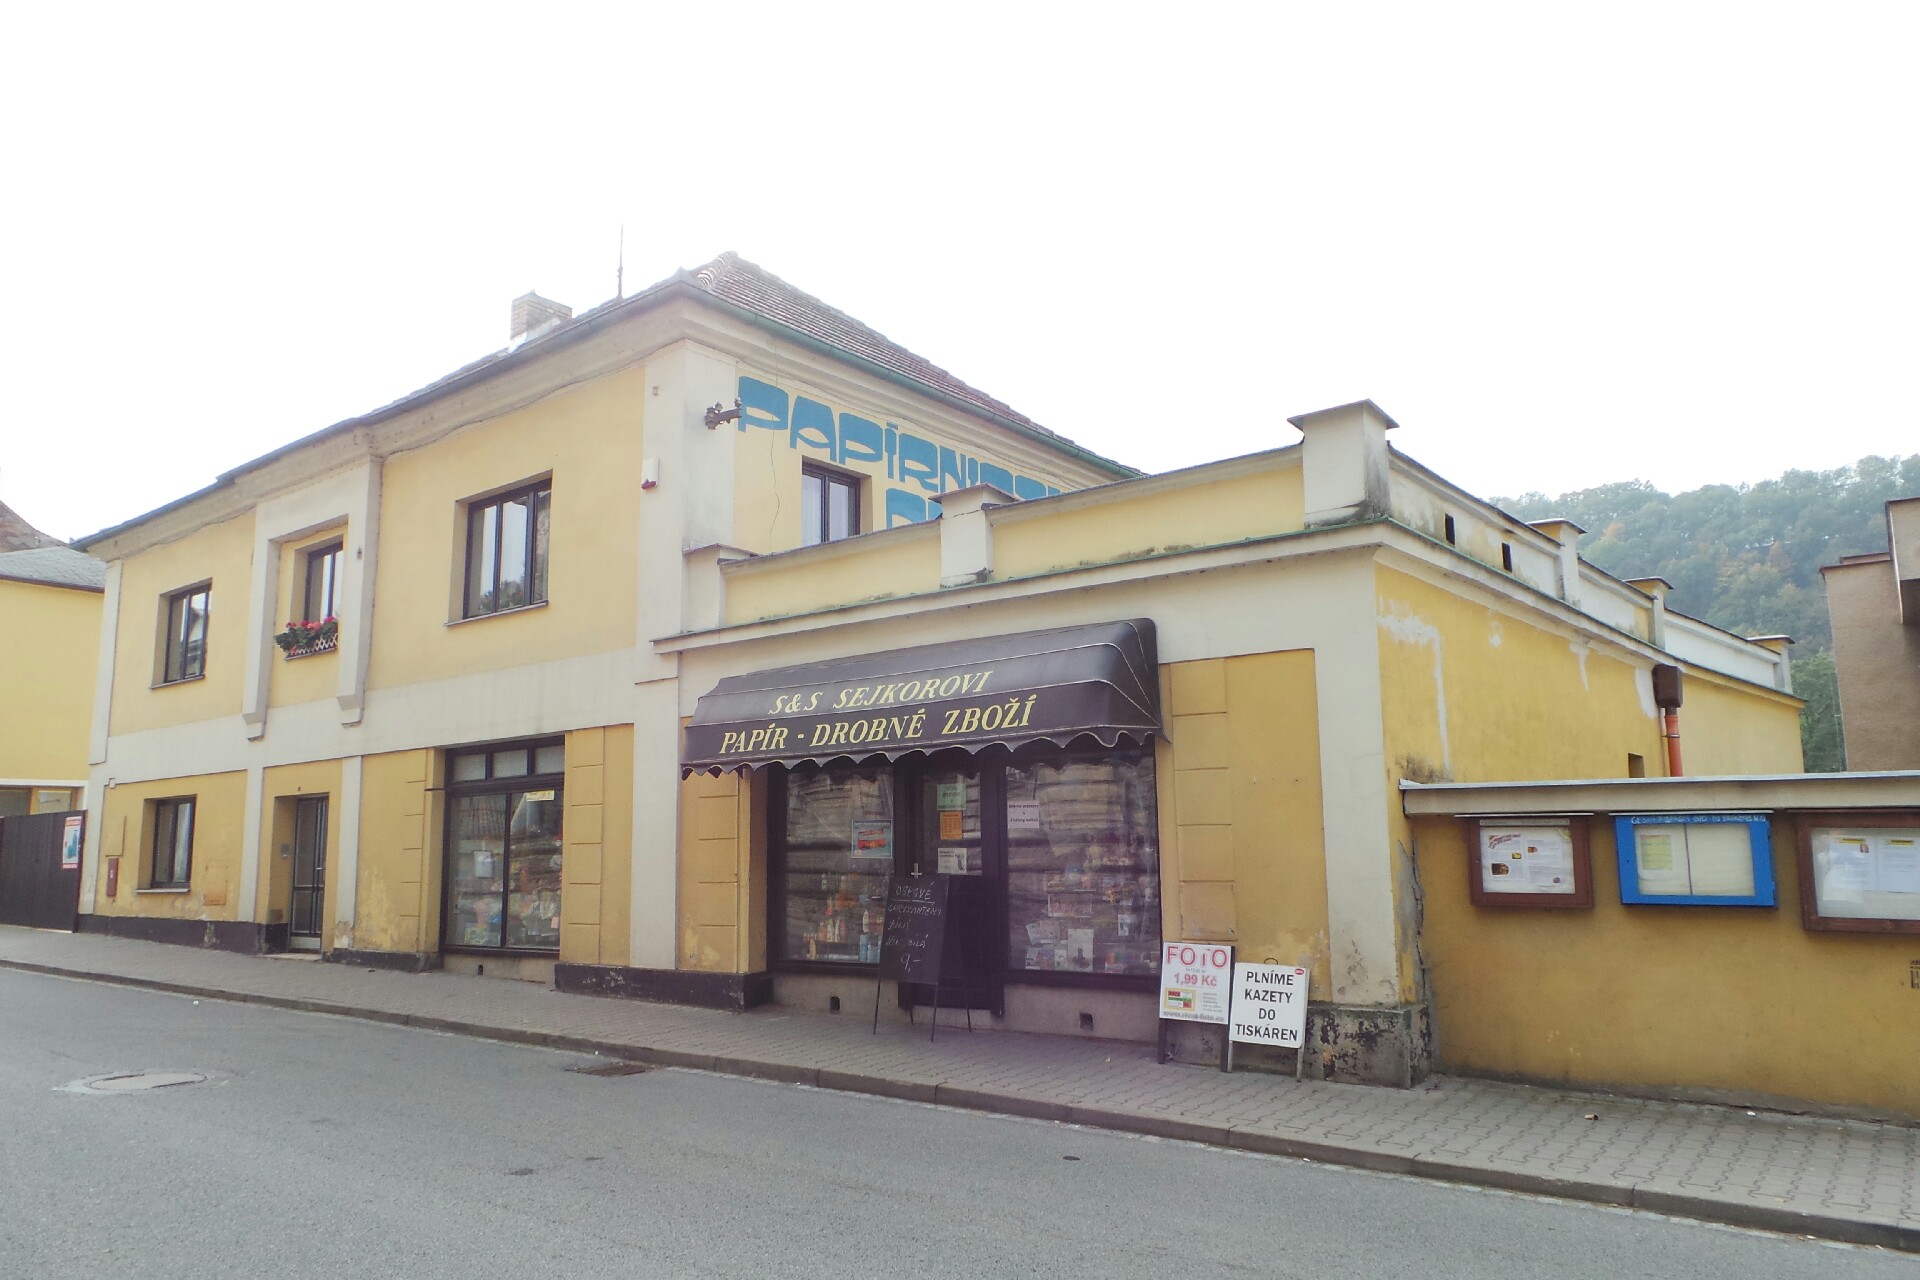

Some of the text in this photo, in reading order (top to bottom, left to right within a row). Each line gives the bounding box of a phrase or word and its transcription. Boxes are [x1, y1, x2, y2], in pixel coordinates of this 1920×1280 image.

[768, 670, 993, 715] S&S SEJKOROVI
[719, 722, 789, 754] PAPÍR
[809, 708, 926, 747] DROBNÉ
[941, 693, 1037, 735] ZBOŽÍ
[1167, 945, 1227, 968] FOTO
[1174, 973, 1217, 987] 1,99 Kč
[1246, 969, 1294, 985] PLNÍME
[1244, 988, 1293, 1003] KAZETY
[1259, 1008, 1276, 1020] DO
[1235, 1023, 1298, 1041] TISKÁREN
